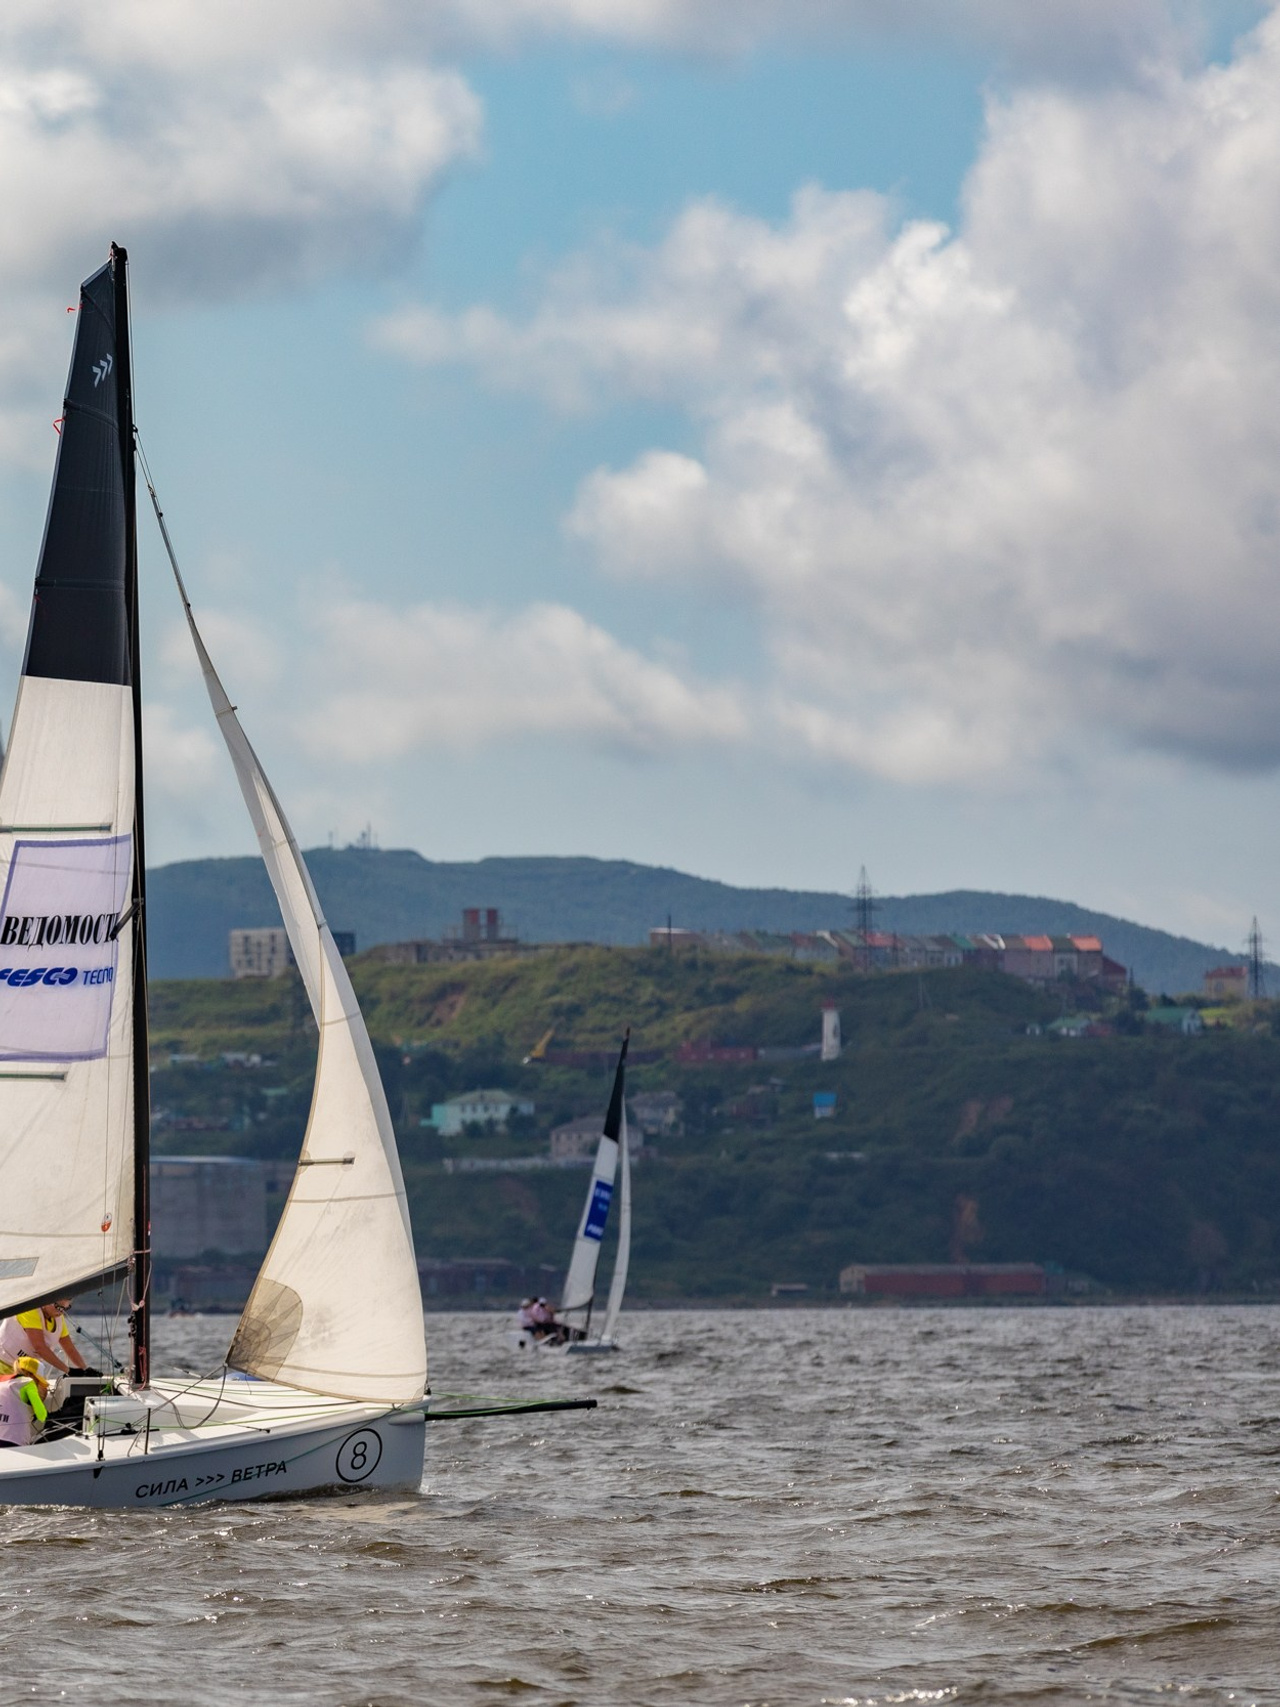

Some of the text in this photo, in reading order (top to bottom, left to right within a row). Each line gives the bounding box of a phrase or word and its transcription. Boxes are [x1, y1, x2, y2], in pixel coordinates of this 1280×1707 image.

[351, 1441, 368, 1470] 8
[135, 1460, 287, 1499] СИЛА ВЕТРА
